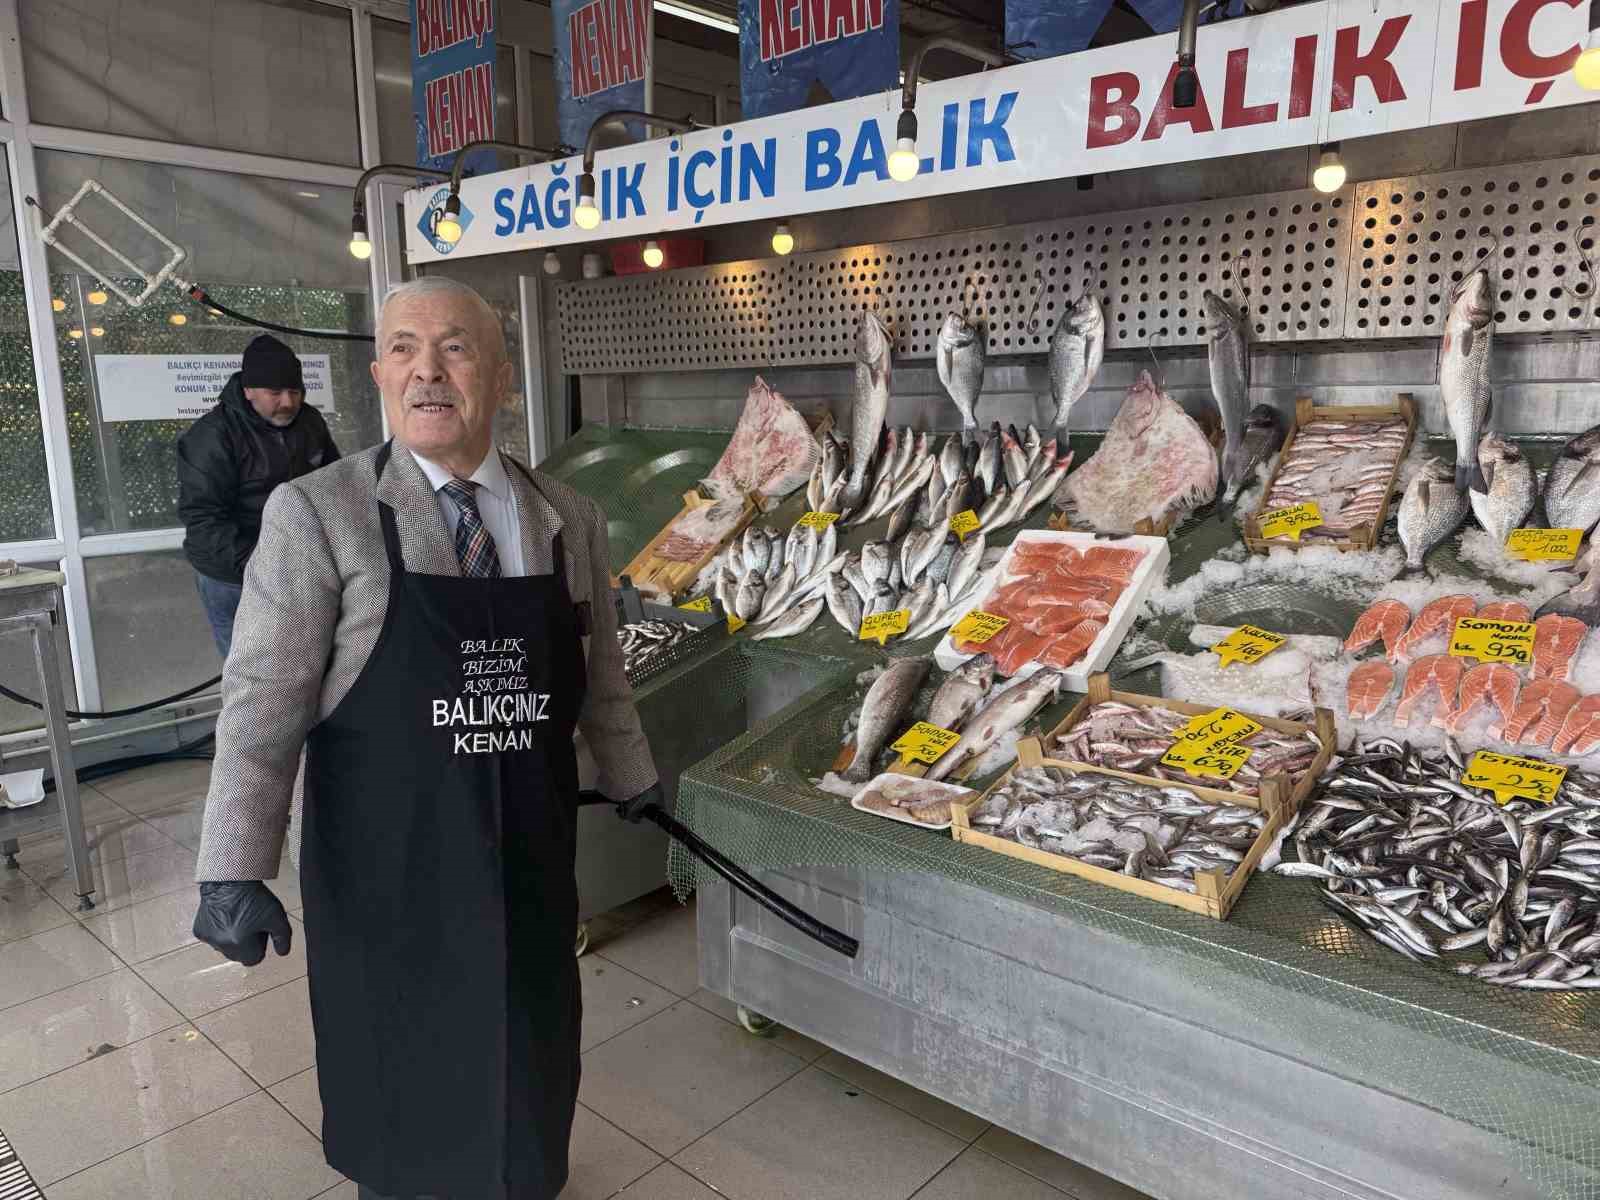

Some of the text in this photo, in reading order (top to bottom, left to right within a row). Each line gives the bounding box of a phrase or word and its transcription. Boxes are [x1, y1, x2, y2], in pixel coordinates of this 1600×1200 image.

[569, 0, 650, 100] KENAN
[1086, 14, 1413, 150] BALIK
[425, 61, 496, 158] KENAN
[494, 91, 1020, 237] SAĞIK İÇİN BAIK
[461, 638, 526, 654] BALIK
[462, 654, 529, 676] BİZİM
[462, 676, 529, 697] AŞKIMIZ
[432, 692, 551, 727] BALIKÇINIZ
[453, 729, 533, 755] KENAN
